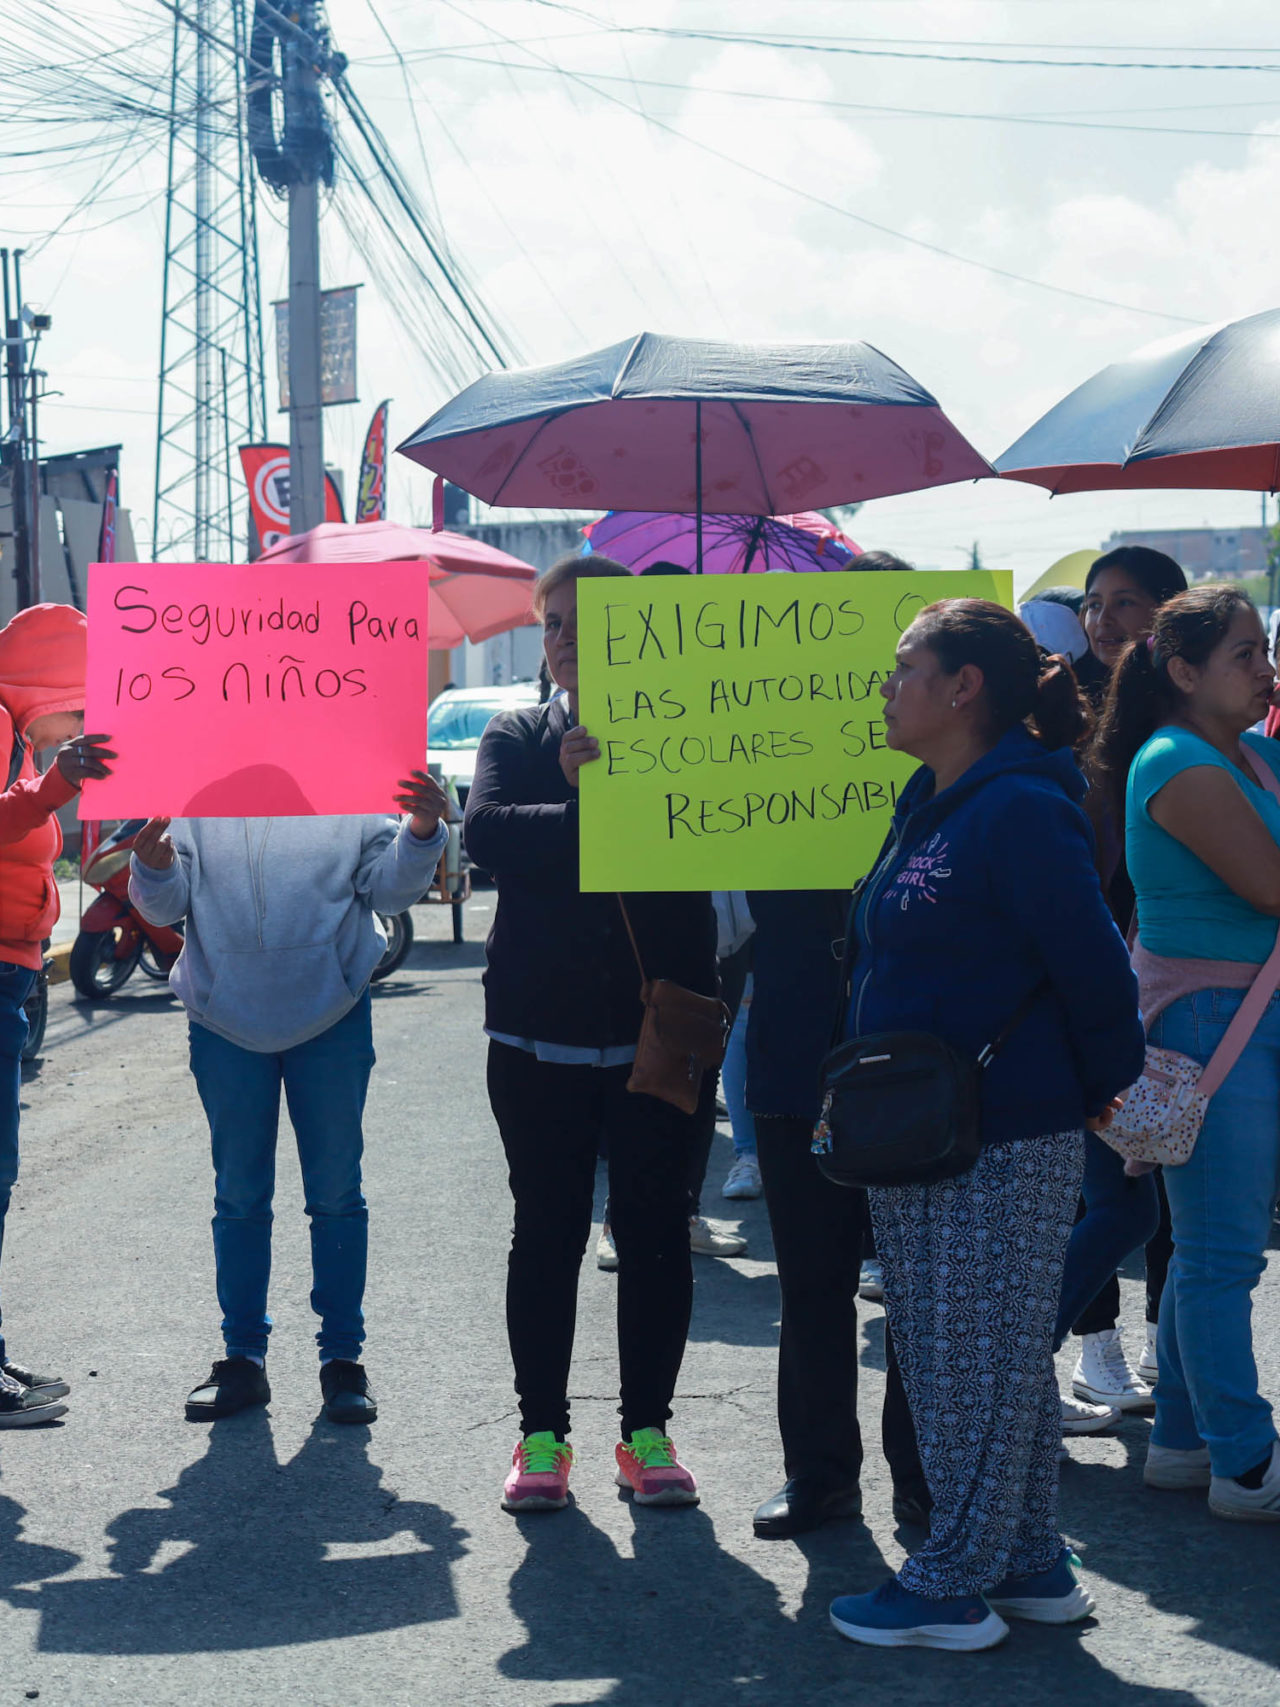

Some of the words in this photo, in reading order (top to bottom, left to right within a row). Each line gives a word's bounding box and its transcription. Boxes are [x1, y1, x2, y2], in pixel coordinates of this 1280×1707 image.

[114, 585, 320, 645] Seguridad
[604, 599, 865, 667] EXIGIMOS
[607, 687, 687, 724] LAS
[607, 731, 814, 776] ESCOLARES
[896, 870, 927, 887] GIRL
